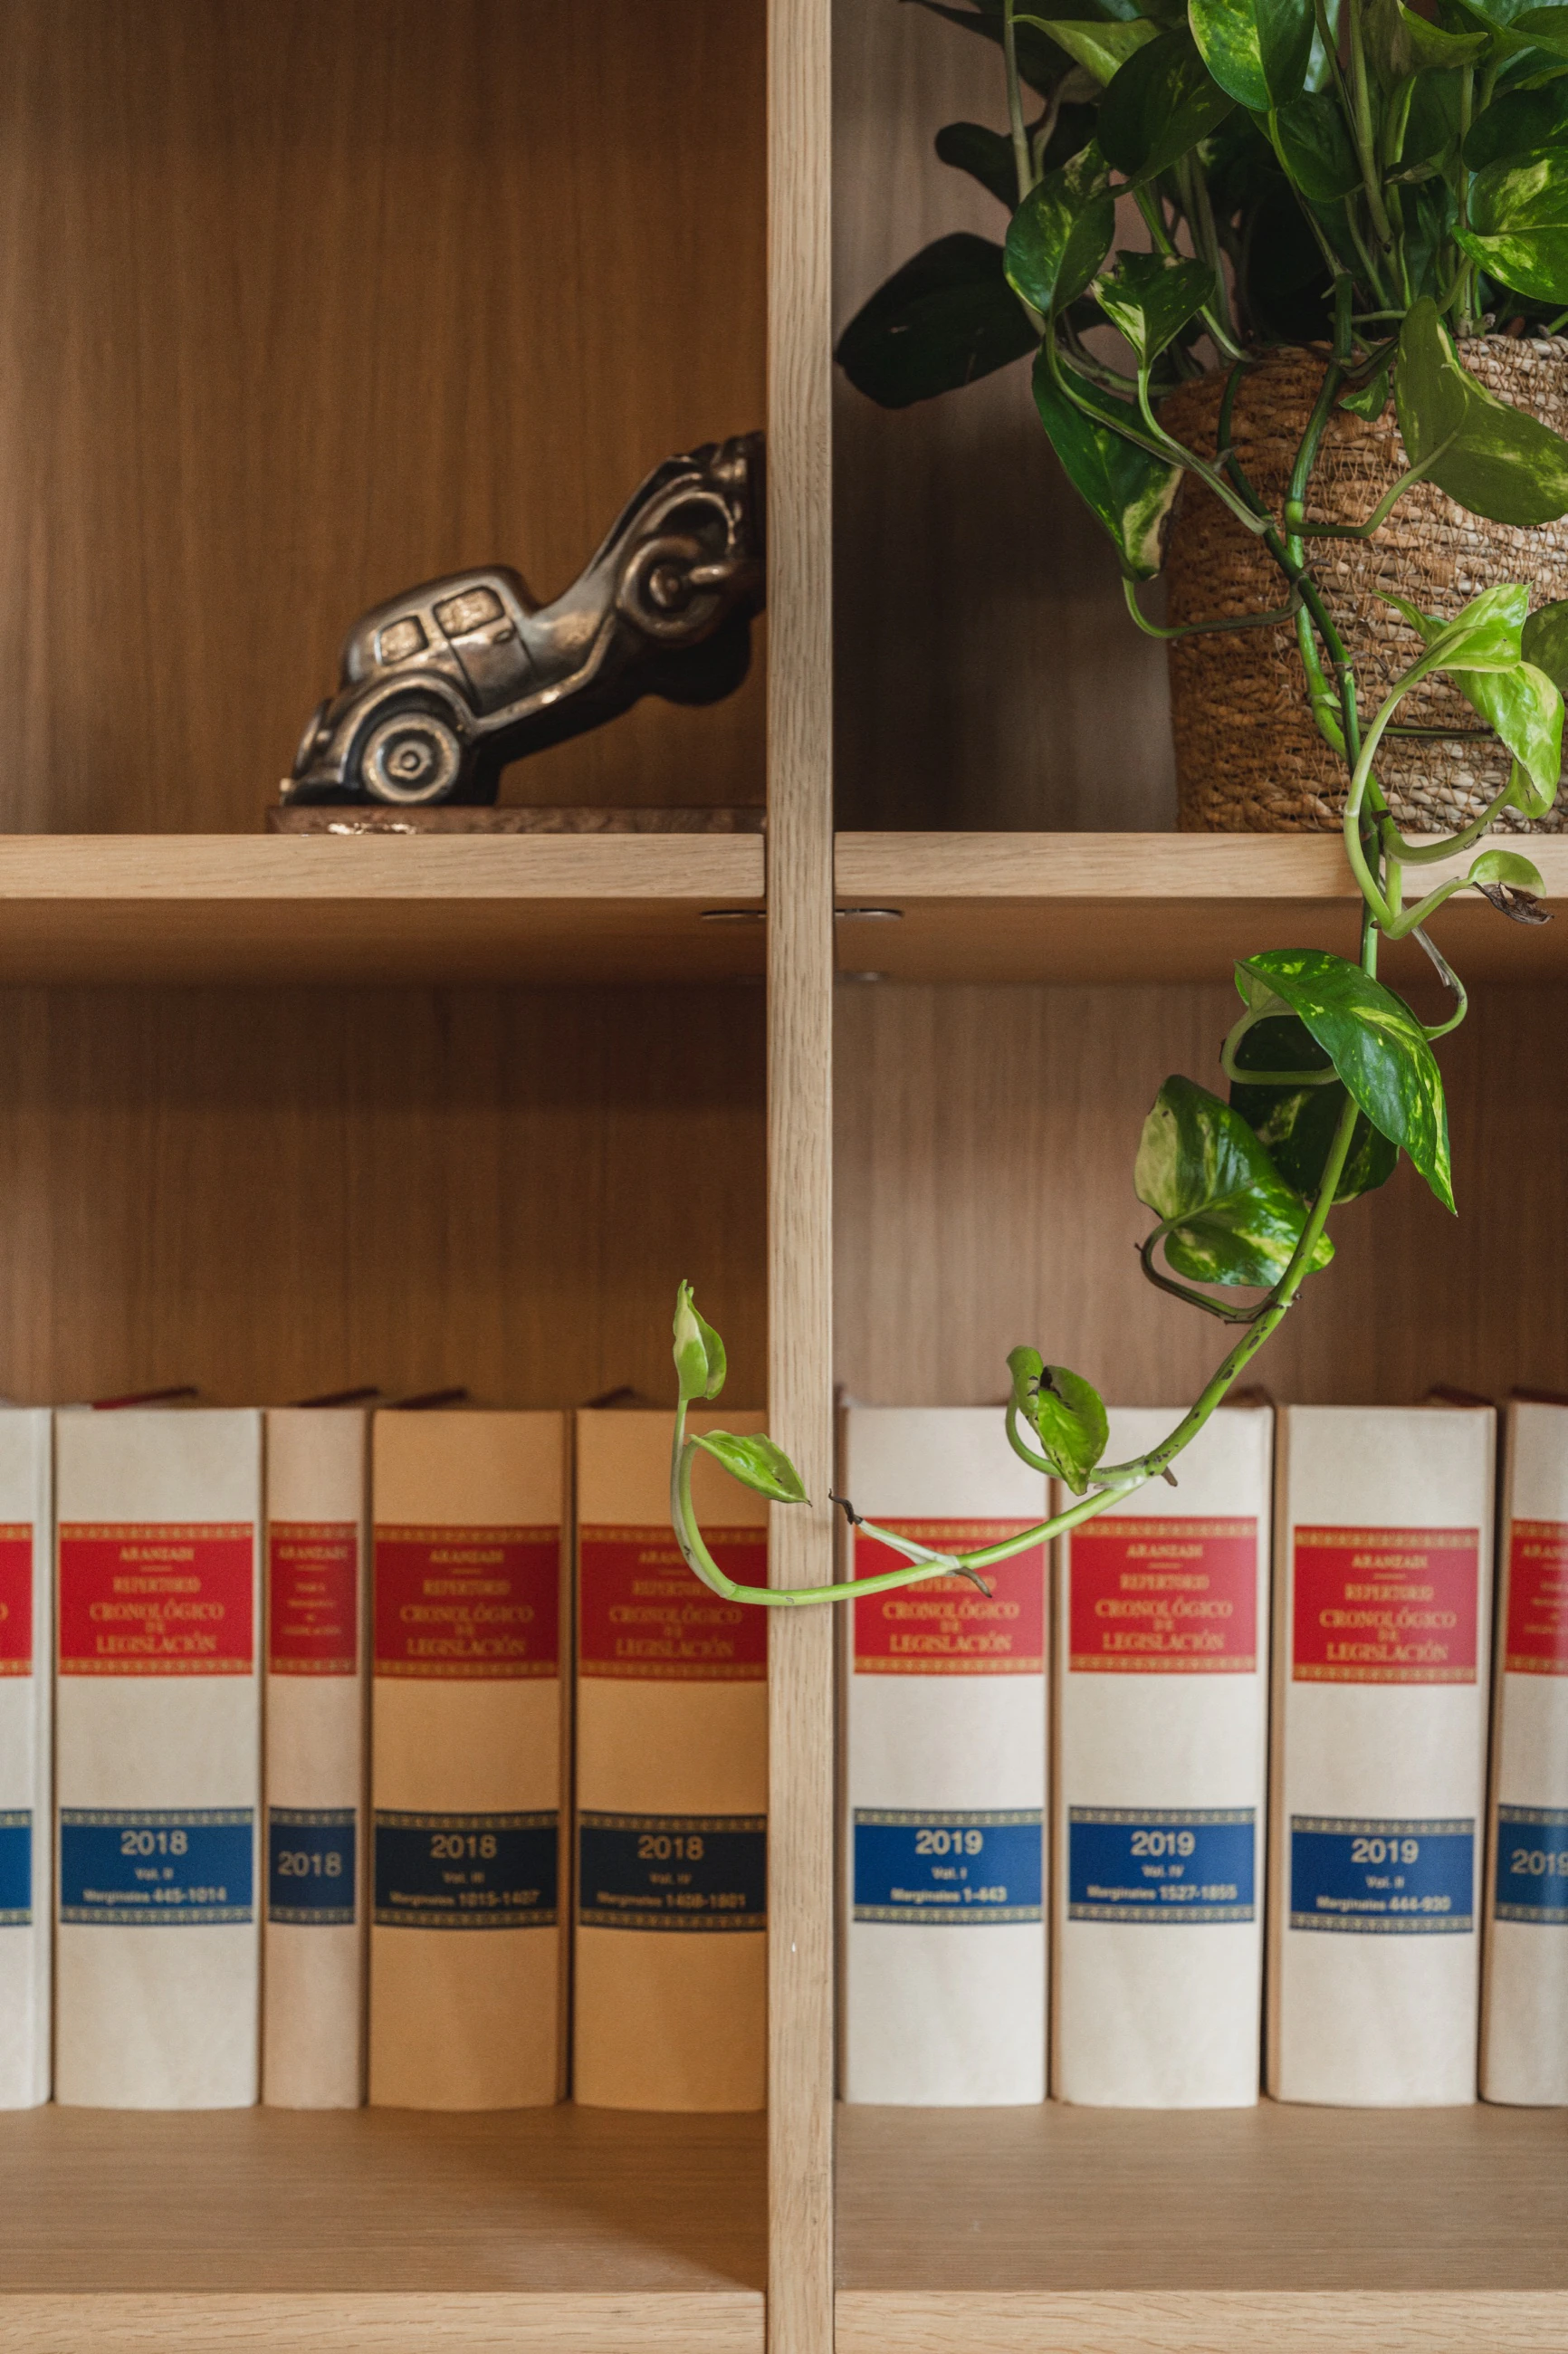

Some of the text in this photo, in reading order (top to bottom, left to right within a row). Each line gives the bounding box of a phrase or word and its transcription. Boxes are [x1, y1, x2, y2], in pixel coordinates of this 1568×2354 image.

[120, 1829, 188, 1856] 2018
[429, 1833, 497, 1860] 2018
[636, 1834, 704, 1861] 2018
[914, 1829, 983, 1856] 2019
[1130, 1831, 1196, 1857] 2019
[1350, 1838, 1420, 1864] 2019
[277, 1851, 343, 1877] 2018
[1509, 1848, 1568, 1875] 2019
